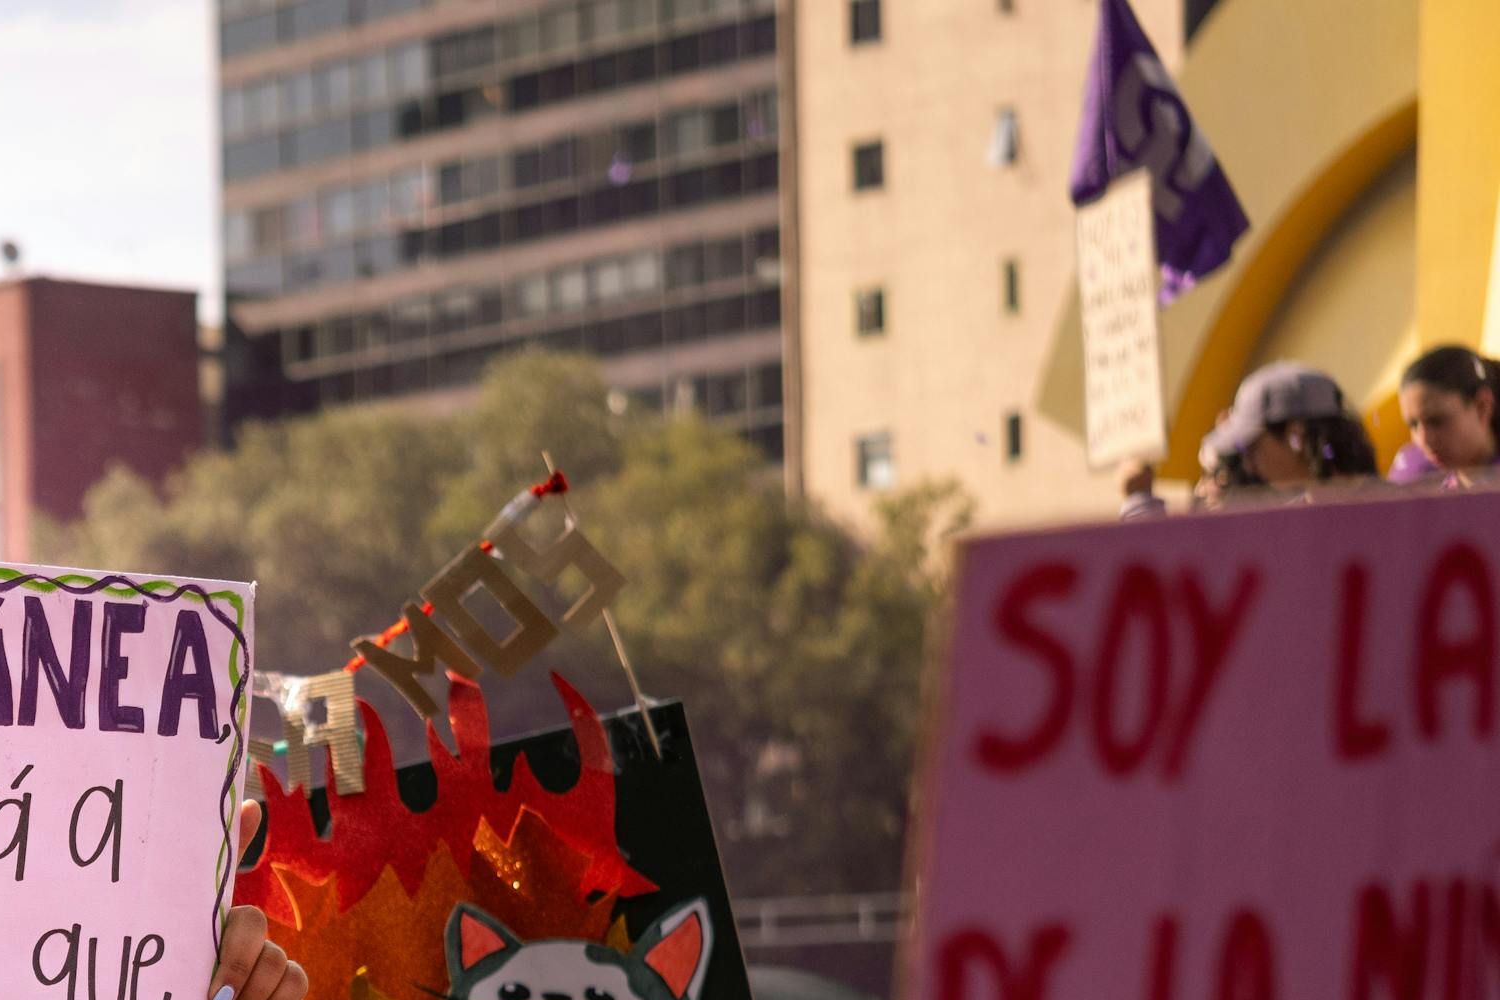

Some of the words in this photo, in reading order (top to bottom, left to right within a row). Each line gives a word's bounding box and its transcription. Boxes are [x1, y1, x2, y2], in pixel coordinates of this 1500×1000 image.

[246, 488, 627, 800] AMOS
[971, 557, 1266, 788] SOY
[1332, 540, 1500, 764] LA
[68, 778, 125, 884] a
